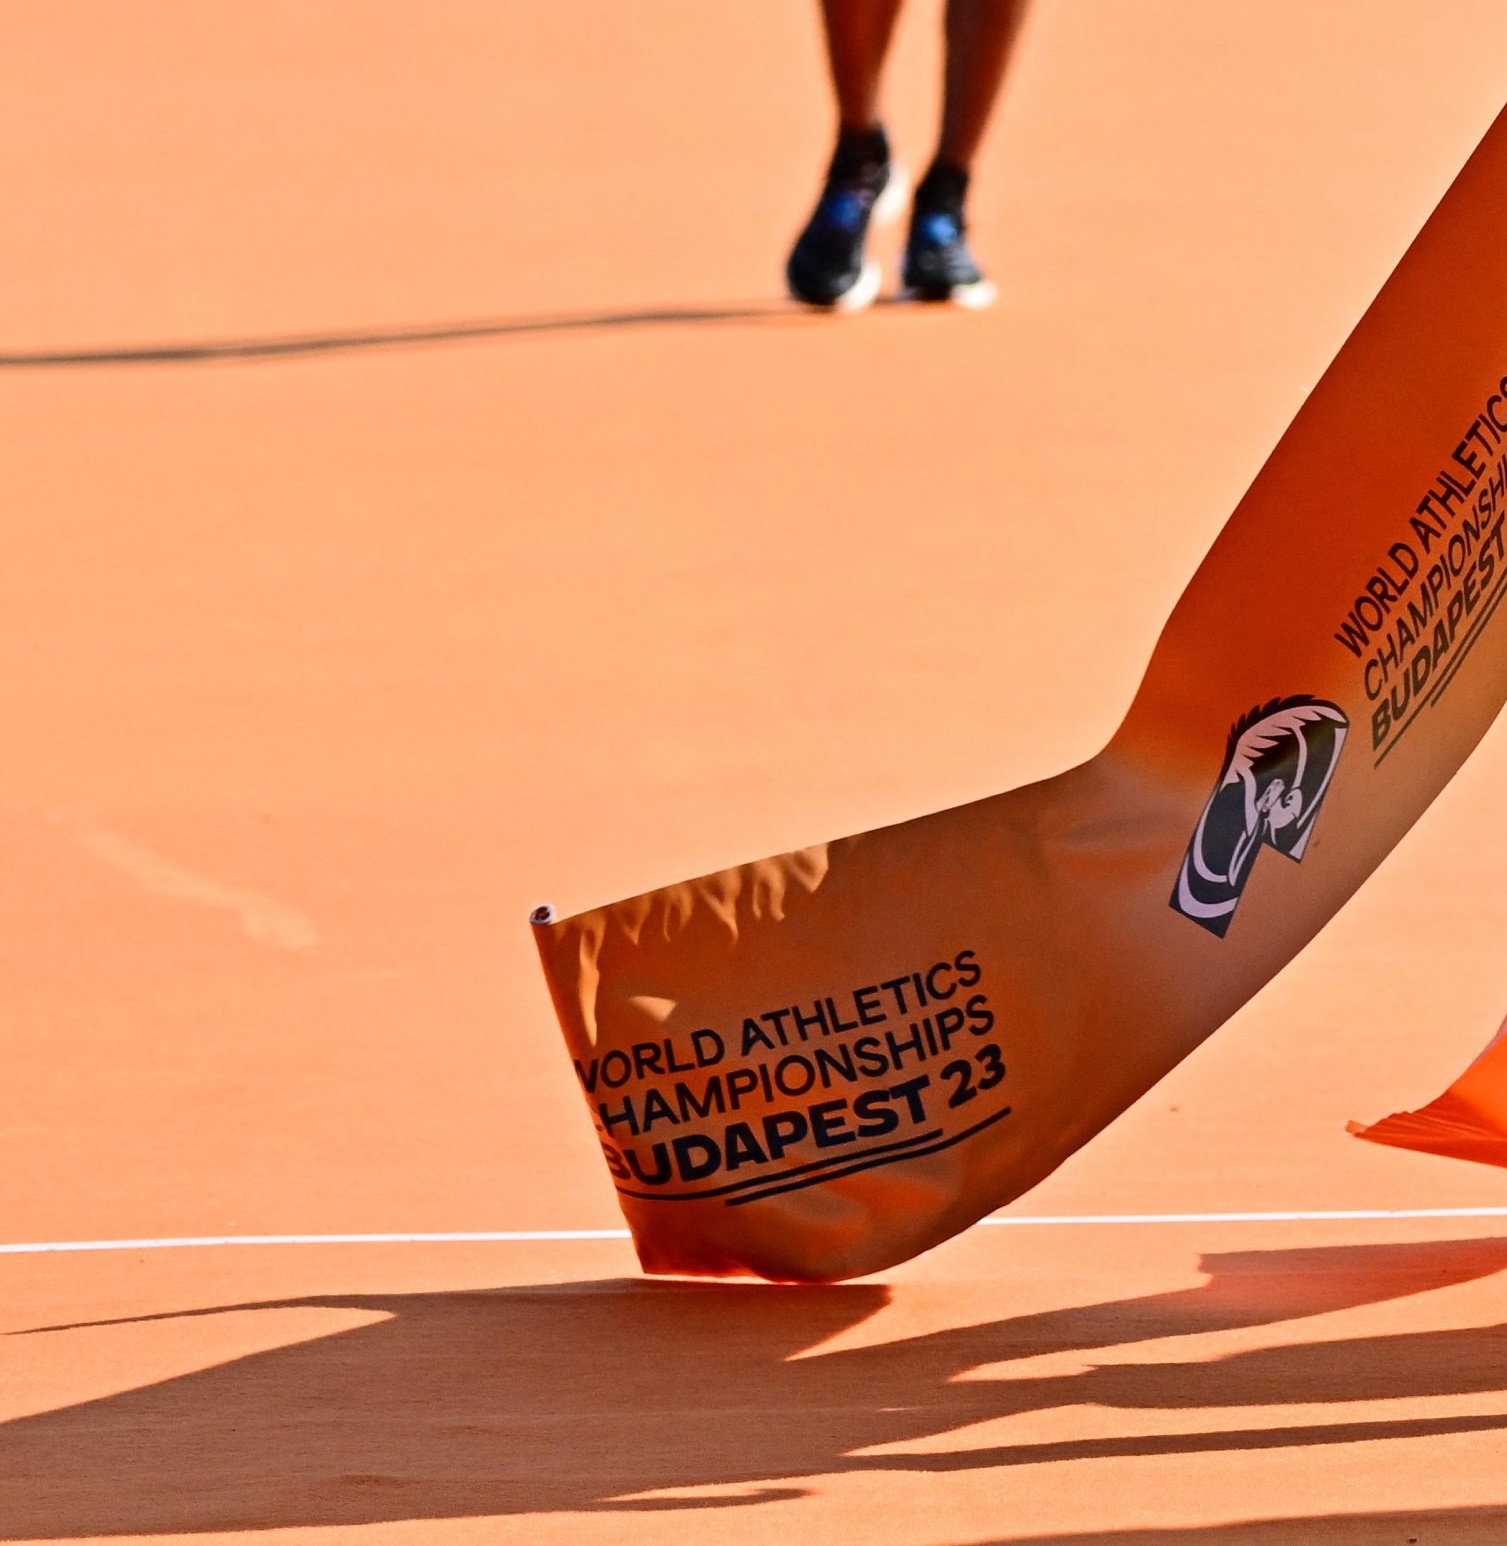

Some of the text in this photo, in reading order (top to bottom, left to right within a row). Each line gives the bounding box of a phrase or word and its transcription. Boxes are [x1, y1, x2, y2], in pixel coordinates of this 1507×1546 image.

[1334, 541, 1420, 658] WORLD
[1371, 510, 1507, 751] BUDAPEST
[740, 950, 982, 1057] ATHLETICS
[596, 994, 995, 1139] HAMPIONSHIPS
[940, 1043, 1007, 1108] 23
